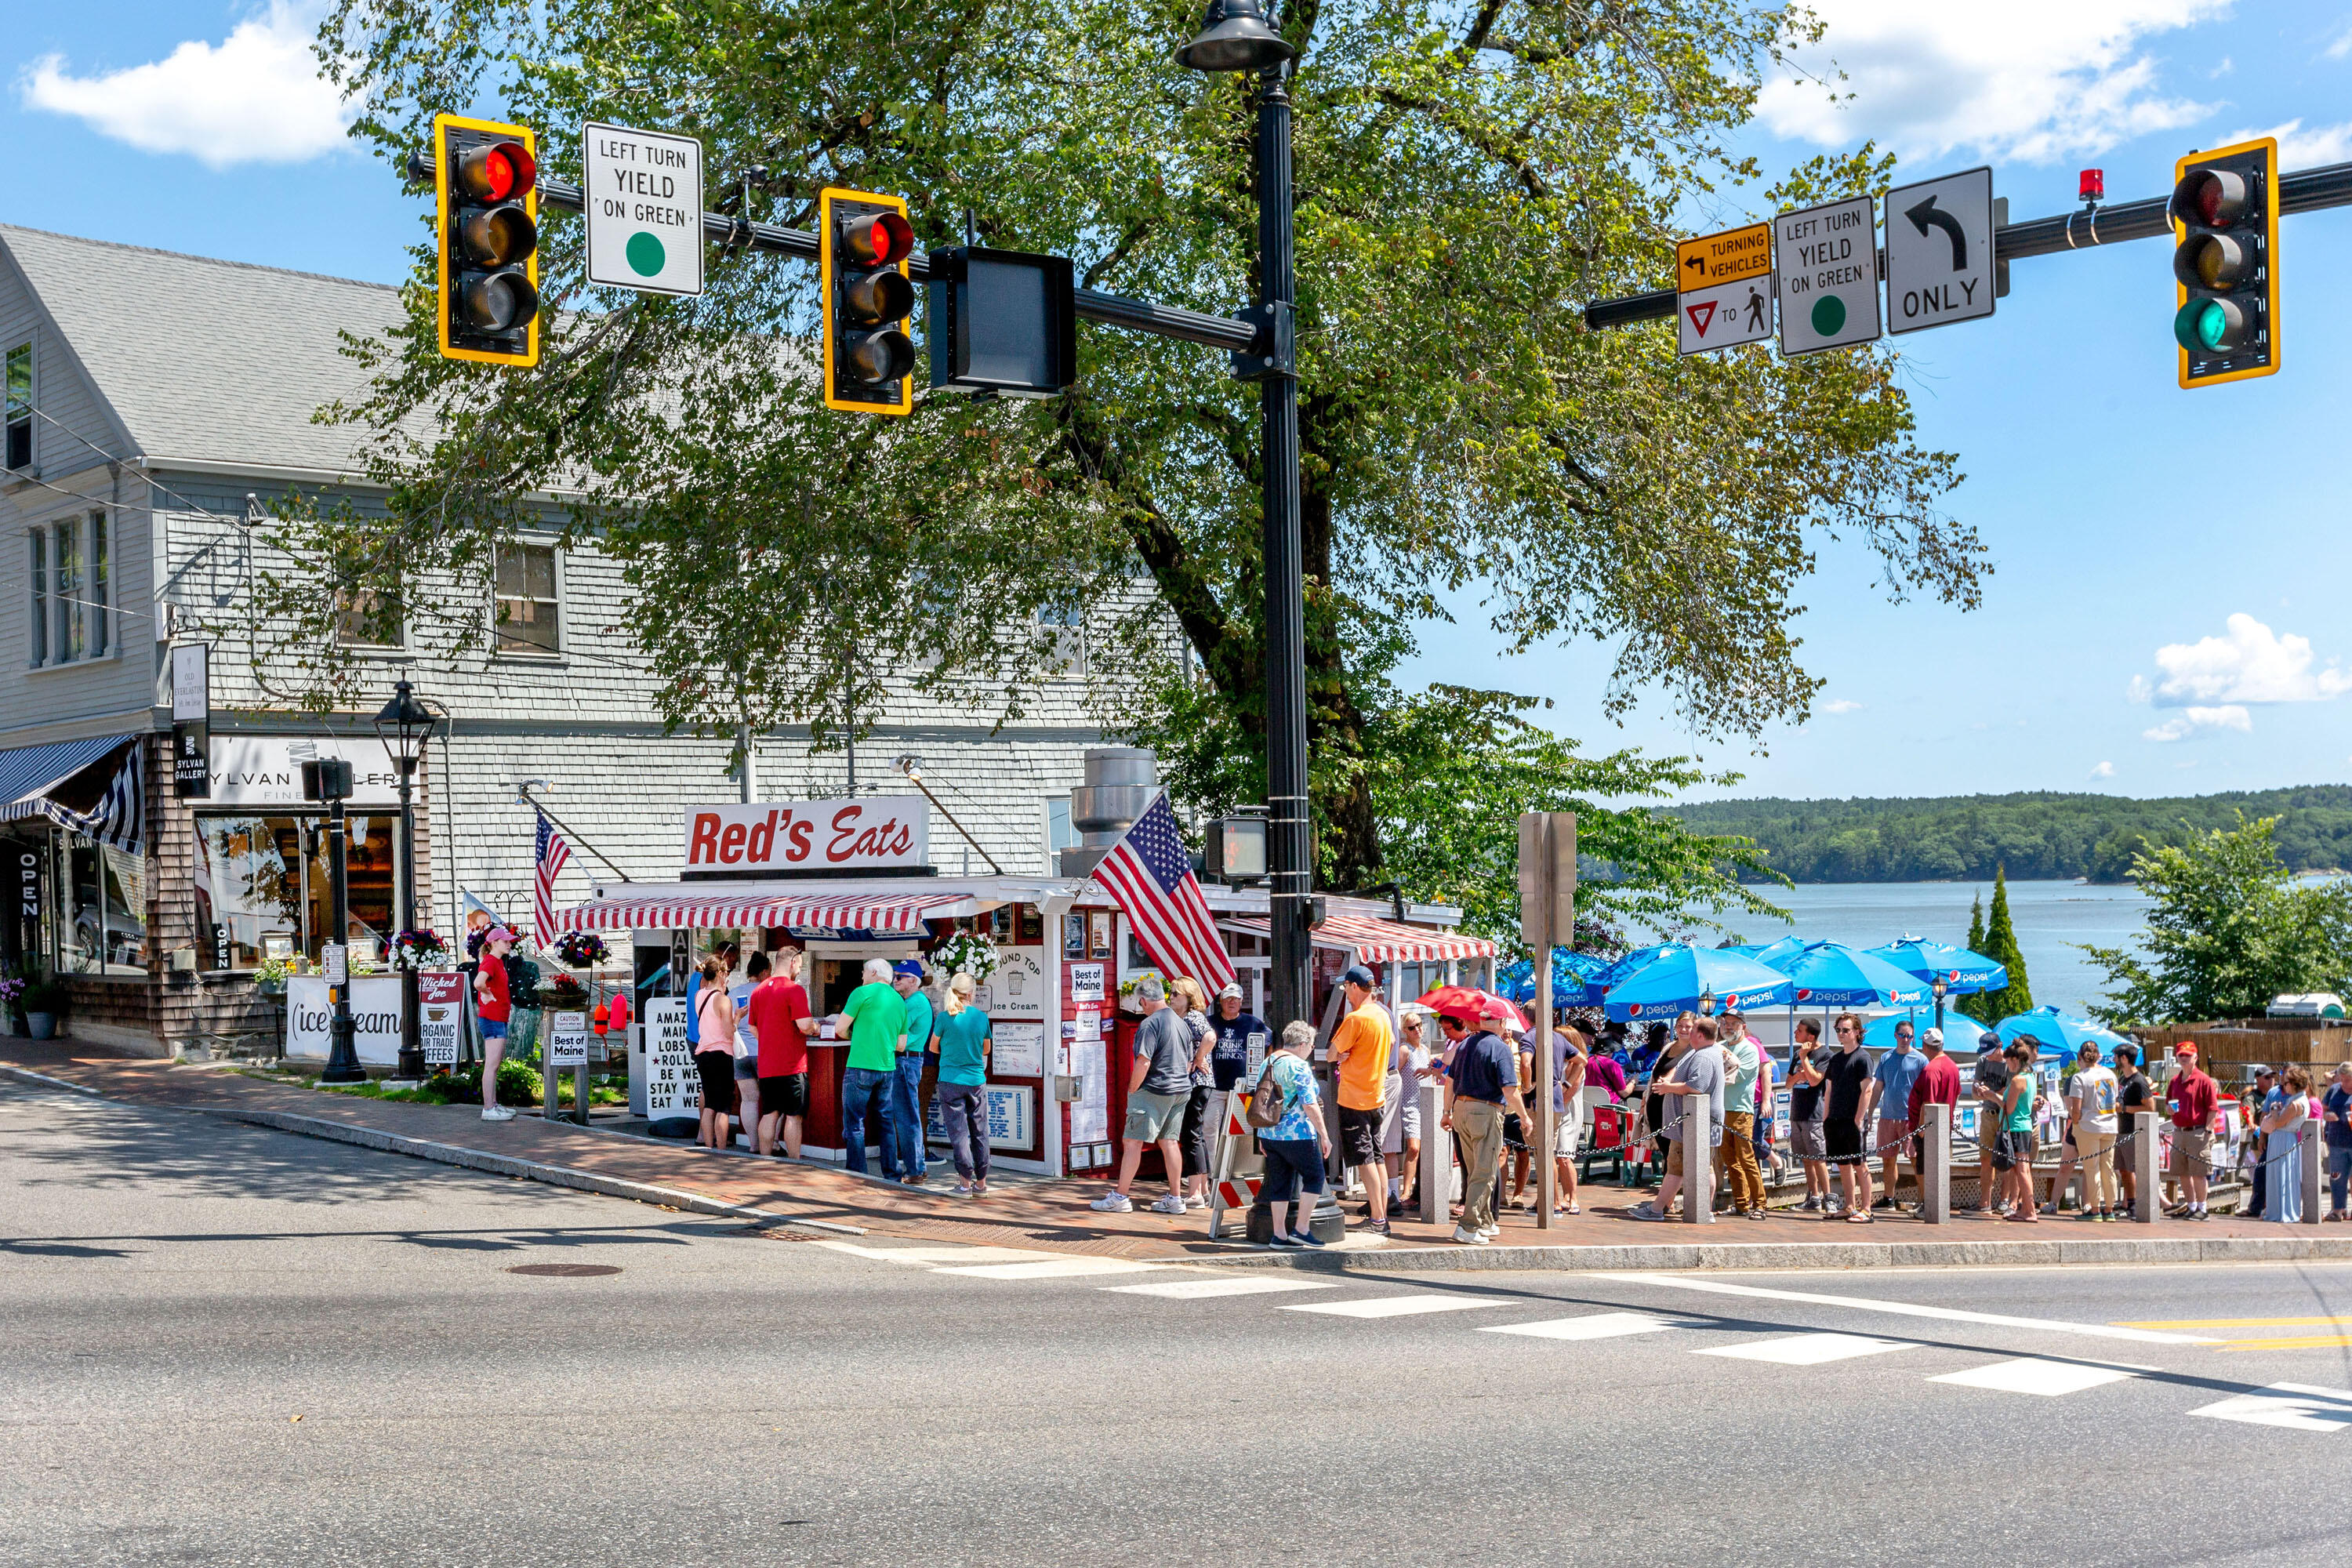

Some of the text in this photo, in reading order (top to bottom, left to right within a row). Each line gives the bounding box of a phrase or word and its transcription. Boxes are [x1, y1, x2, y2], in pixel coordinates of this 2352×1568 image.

[601, 140, 686, 169] LEFT TURN
[615, 169, 674, 198] YIELD
[604, 199, 684, 227] ON GREEN
[1787, 209, 1861, 241] LEFT TURN
[1711, 233, 1764, 257] TURNING
[1798, 238, 1851, 267] YIELD
[1711, 253, 1766, 278] VEHICLES
[1791, 265, 1863, 294] ON GREEN
[1903, 277, 1979, 318] ONLY
[1722, 308, 1737, 322] TO
[184, 672, 194, 681] OLD
[174, 684, 205, 696] EVERLASTING
[177, 759, 204, 769] SYLVAN
[175, 769, 206, 779] GALLERY
[210, 773, 290, 785] YLVAN
[688, 805, 914, 865] Red's Eats
[58, 838, 93, 850] SYLVAN
[20, 853, 38, 916] OPEN
[217, 929, 228, 967] OPEN
[673, 931, 688, 993] ATM
[1025, 956, 1040, 975] TOP
[1075, 969, 1100, 979] Best of
[1962, 971, 1988, 982] pepsi
[419, 976, 458, 987] Wicked
[1075, 980, 1101, 990] Maine
[427, 987, 447, 1000] Joe
[1742, 989, 1774, 1007] pepsi
[1815, 992, 1850, 1003] pepsi
[1901, 990, 1920, 1004] pepsi
[1646, 1004, 1678, 1016] pepsi
[656, 1012, 687, 1024] AMAZ
[662, 1026, 688, 1038] MAIN
[420, 1038, 453, 1047] AIR TRADE
[554, 1036, 584, 1044] Best of
[554, 1046, 584, 1055] Maine
[659, 1041, 685, 1052] LOBS
[424, 1048, 453, 1060] FFEES
[662, 1054, 697, 1066] ROLLS
[660, 1069, 699, 1080] BE WE
[650, 1082, 702, 1094] STAY WE
[652, 1096, 699, 1109] EAT WE
